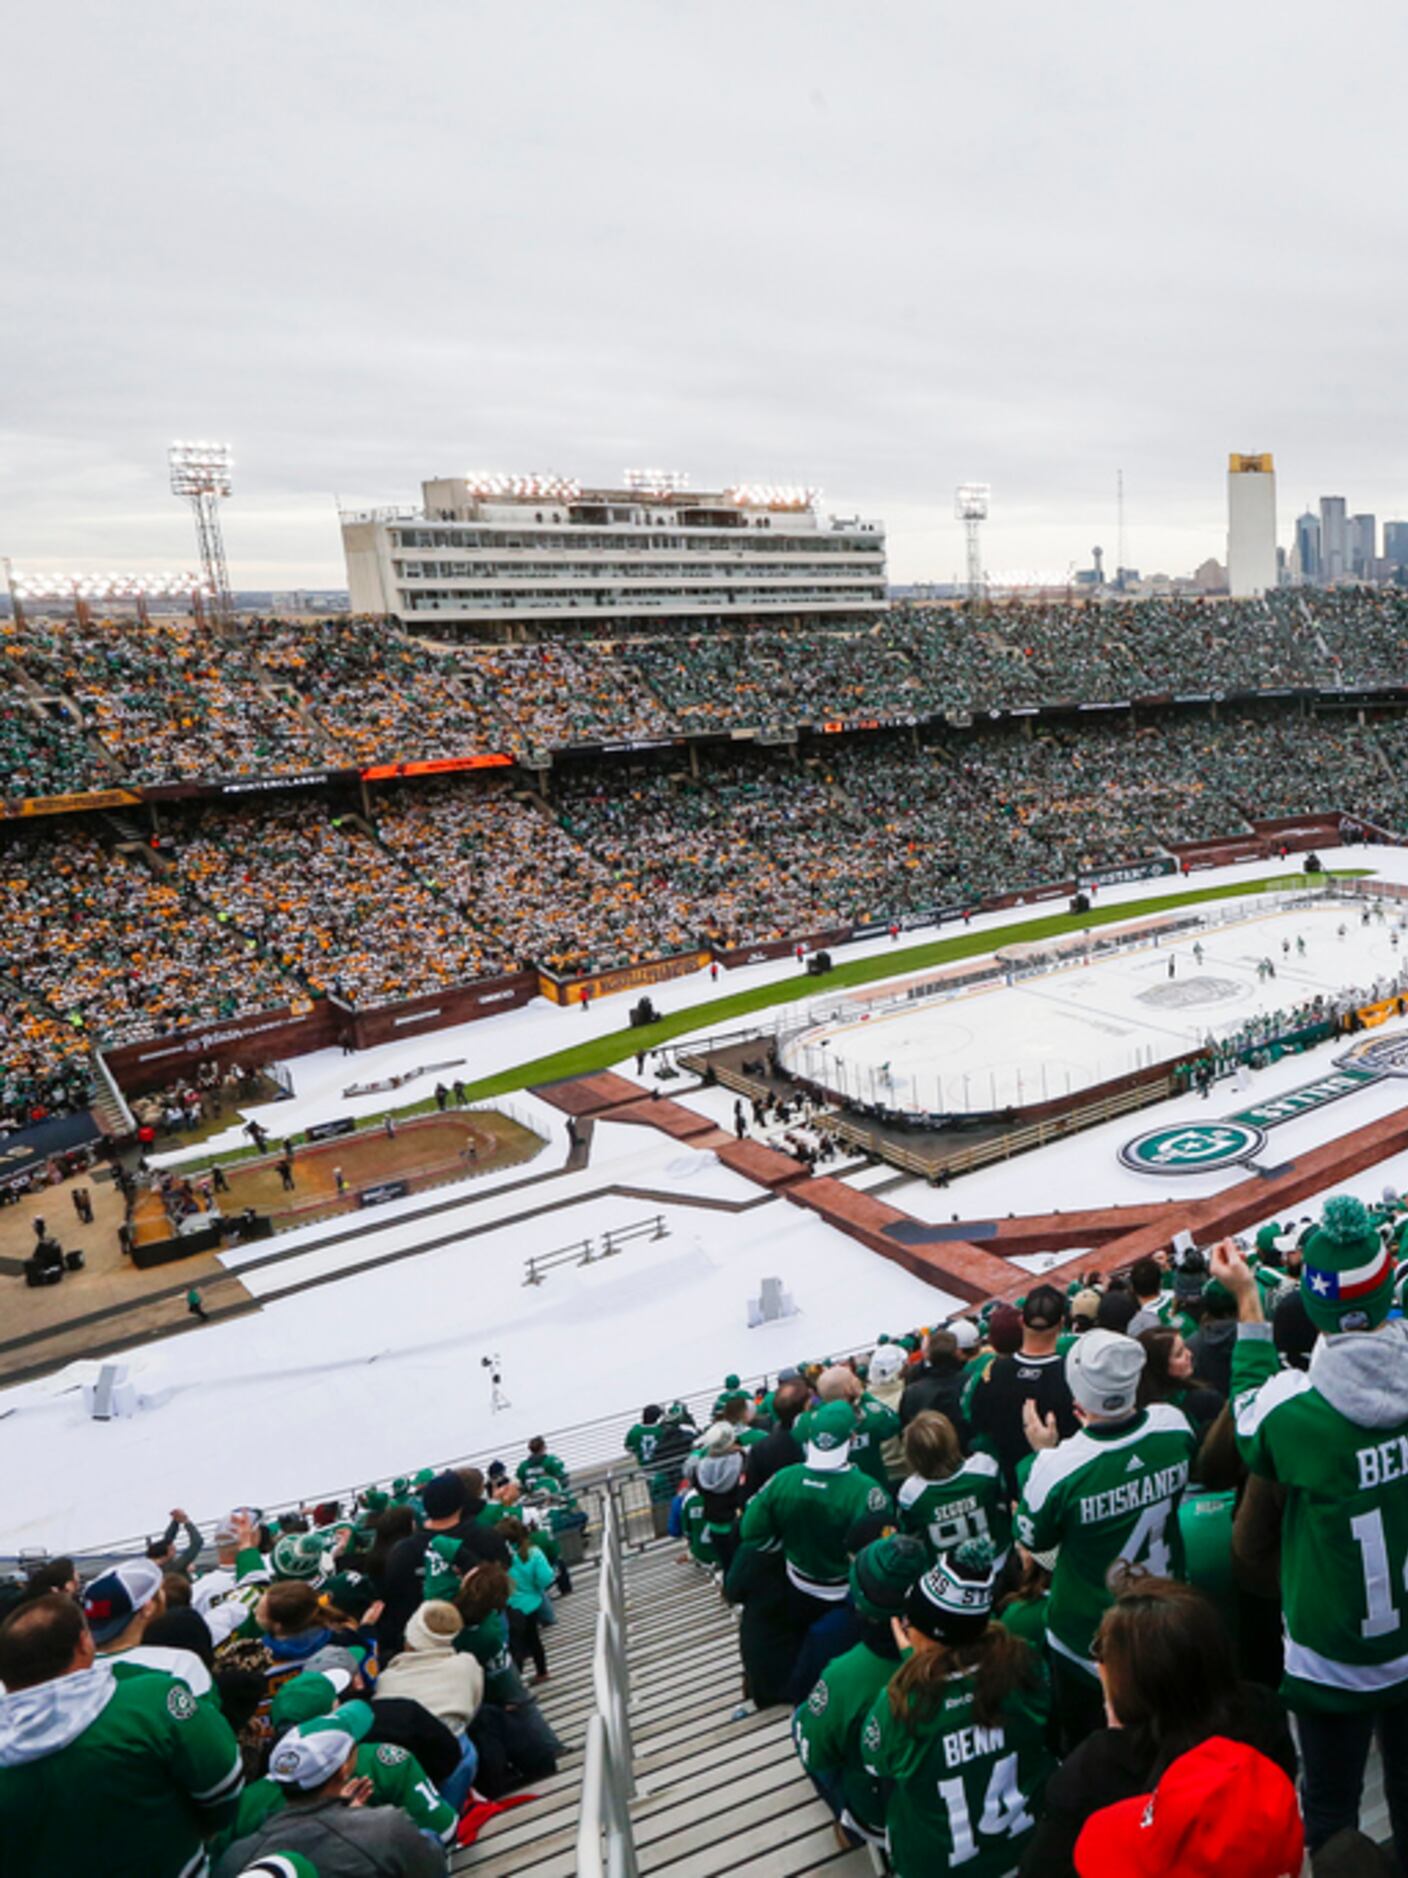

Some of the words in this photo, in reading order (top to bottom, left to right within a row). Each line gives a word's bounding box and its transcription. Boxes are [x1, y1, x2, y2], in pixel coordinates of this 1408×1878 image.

[1080, 1459, 1189, 1524] HEISKANEN
[1118, 1498, 1173, 1579] 4
[943, 1724, 1005, 1768] BENN
[937, 1752, 1036, 1868] 14
